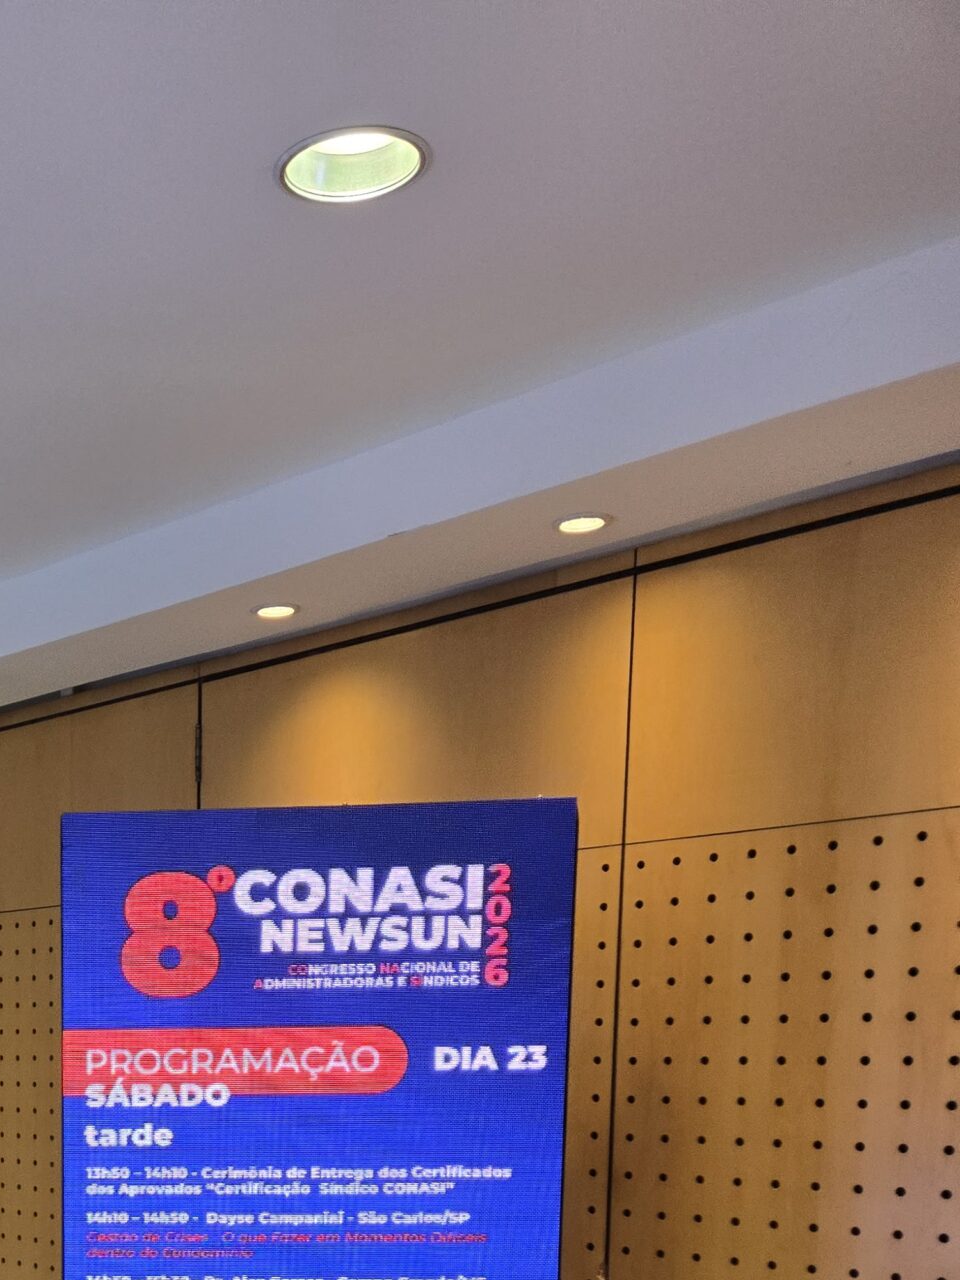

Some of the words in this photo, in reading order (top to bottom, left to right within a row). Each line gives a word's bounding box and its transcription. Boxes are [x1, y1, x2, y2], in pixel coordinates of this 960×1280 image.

[233, 863, 485, 915] CONASI
[260, 915, 482, 953] NEWSUN
[483, 863, 512, 988] 2026
[288, 963, 376, 975] CONGRESSO
[379, 961, 455, 974] NACIONAL
[459, 961, 480, 972] DE
[253, 977, 392, 990] ADMINISTRADORAS
[397, 977, 407, 987] E
[85, 1041, 380, 1080] PROGRAMAÇÃO
[434, 1045, 498, 1071] DIA
[507, 1045, 547, 1071] 23
[85, 1080, 231, 1108] SÁBADO
[84, 1123, 174, 1147] tarde
[144, 1167, 188, 1179] 14h10
[201, 1166, 282, 1179] Cerimônia
[286, 1167, 306, 1179] de
[310, 1166, 373, 1181] Entrega
[377, 1166, 408, 1179] dos
[411, 1165, 512, 1179] Certificados
[85, 1183, 115, 1195] dos
[118, 1183, 202, 1197] Aprovados
[86, 1212, 129, 1224] 14h10
[143, 1212, 189, 1224] 14h50
[206, 1212, 254, 1225] Dayse
[357, 1211, 387, 1224] São
[391, 1210, 470, 1225] Carlos/SP
[345, 1232, 425, 1242] Momentos
